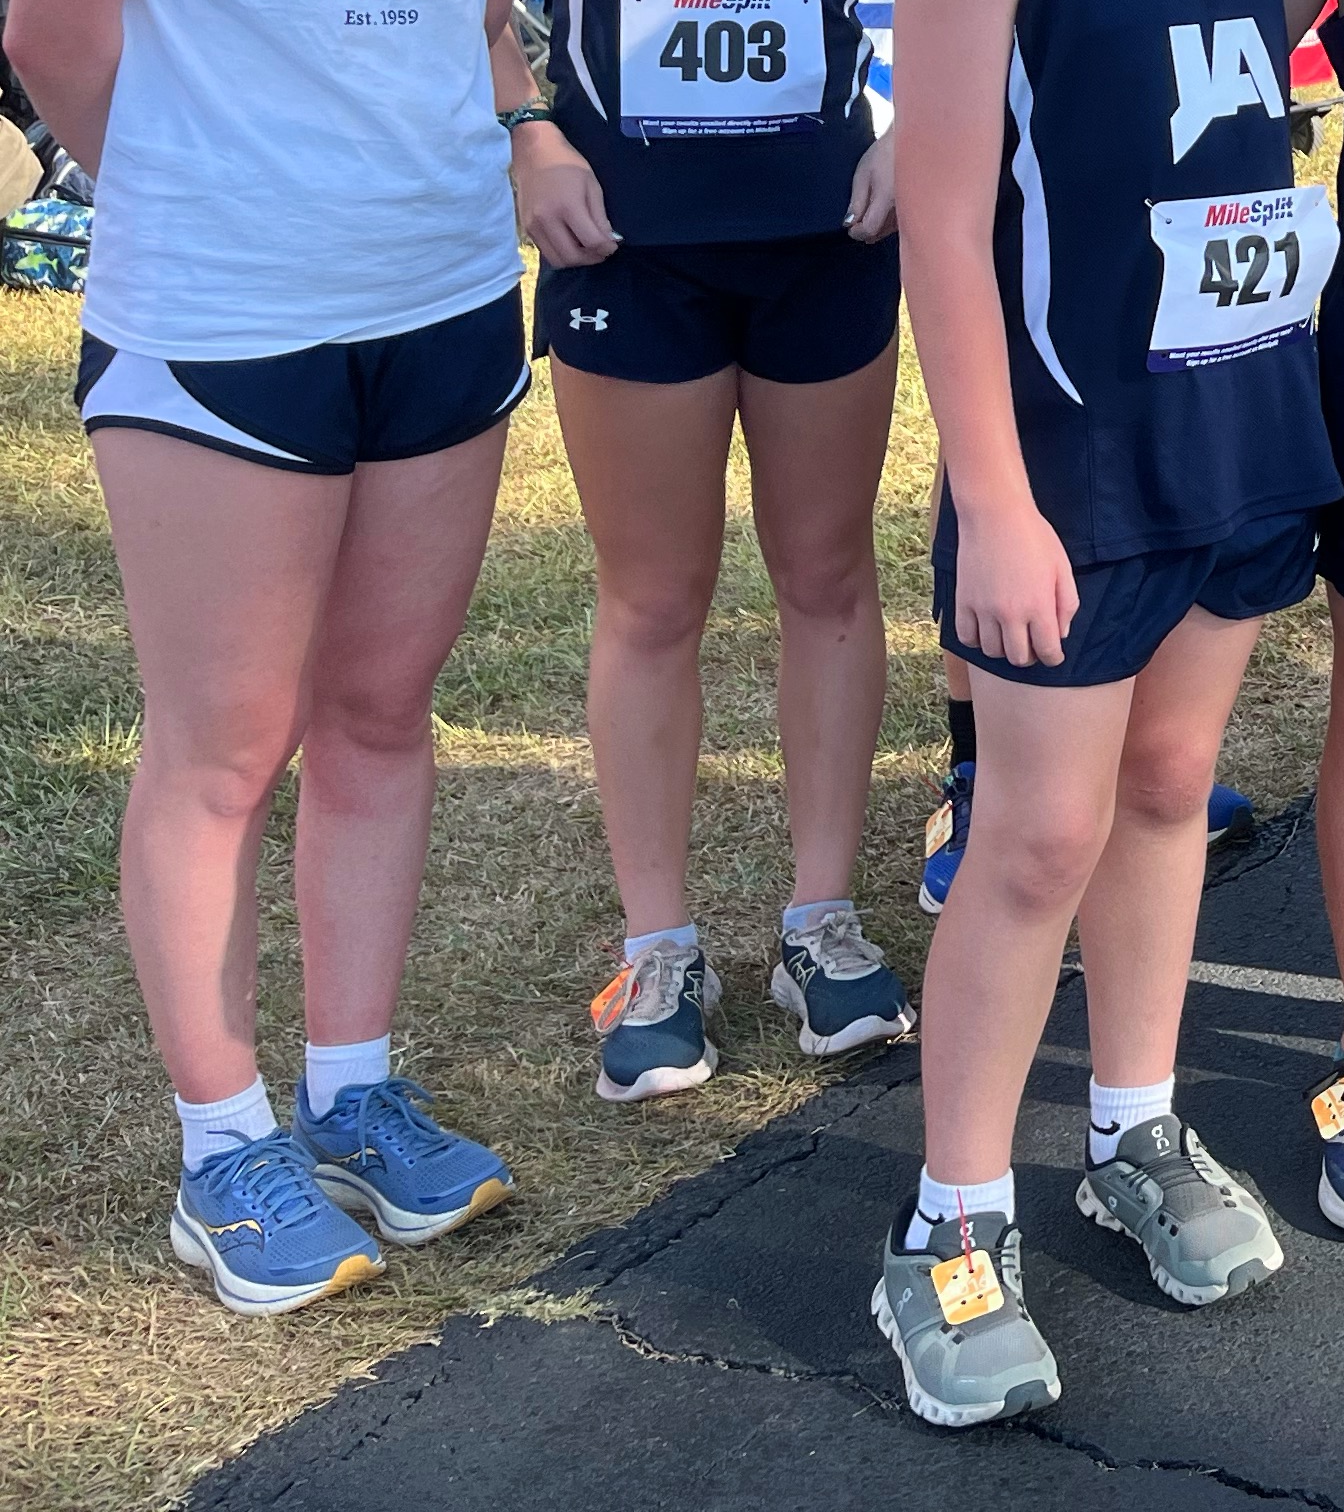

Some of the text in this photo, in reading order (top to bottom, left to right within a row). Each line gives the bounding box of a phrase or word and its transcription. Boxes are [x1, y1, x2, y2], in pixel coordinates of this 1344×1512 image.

[659, 19, 788, 83] 403
[1168, 17, 1285, 165] JA
[1204, 196, 1294, 227] MileSplit
[1200, 231, 1300, 308] 421
